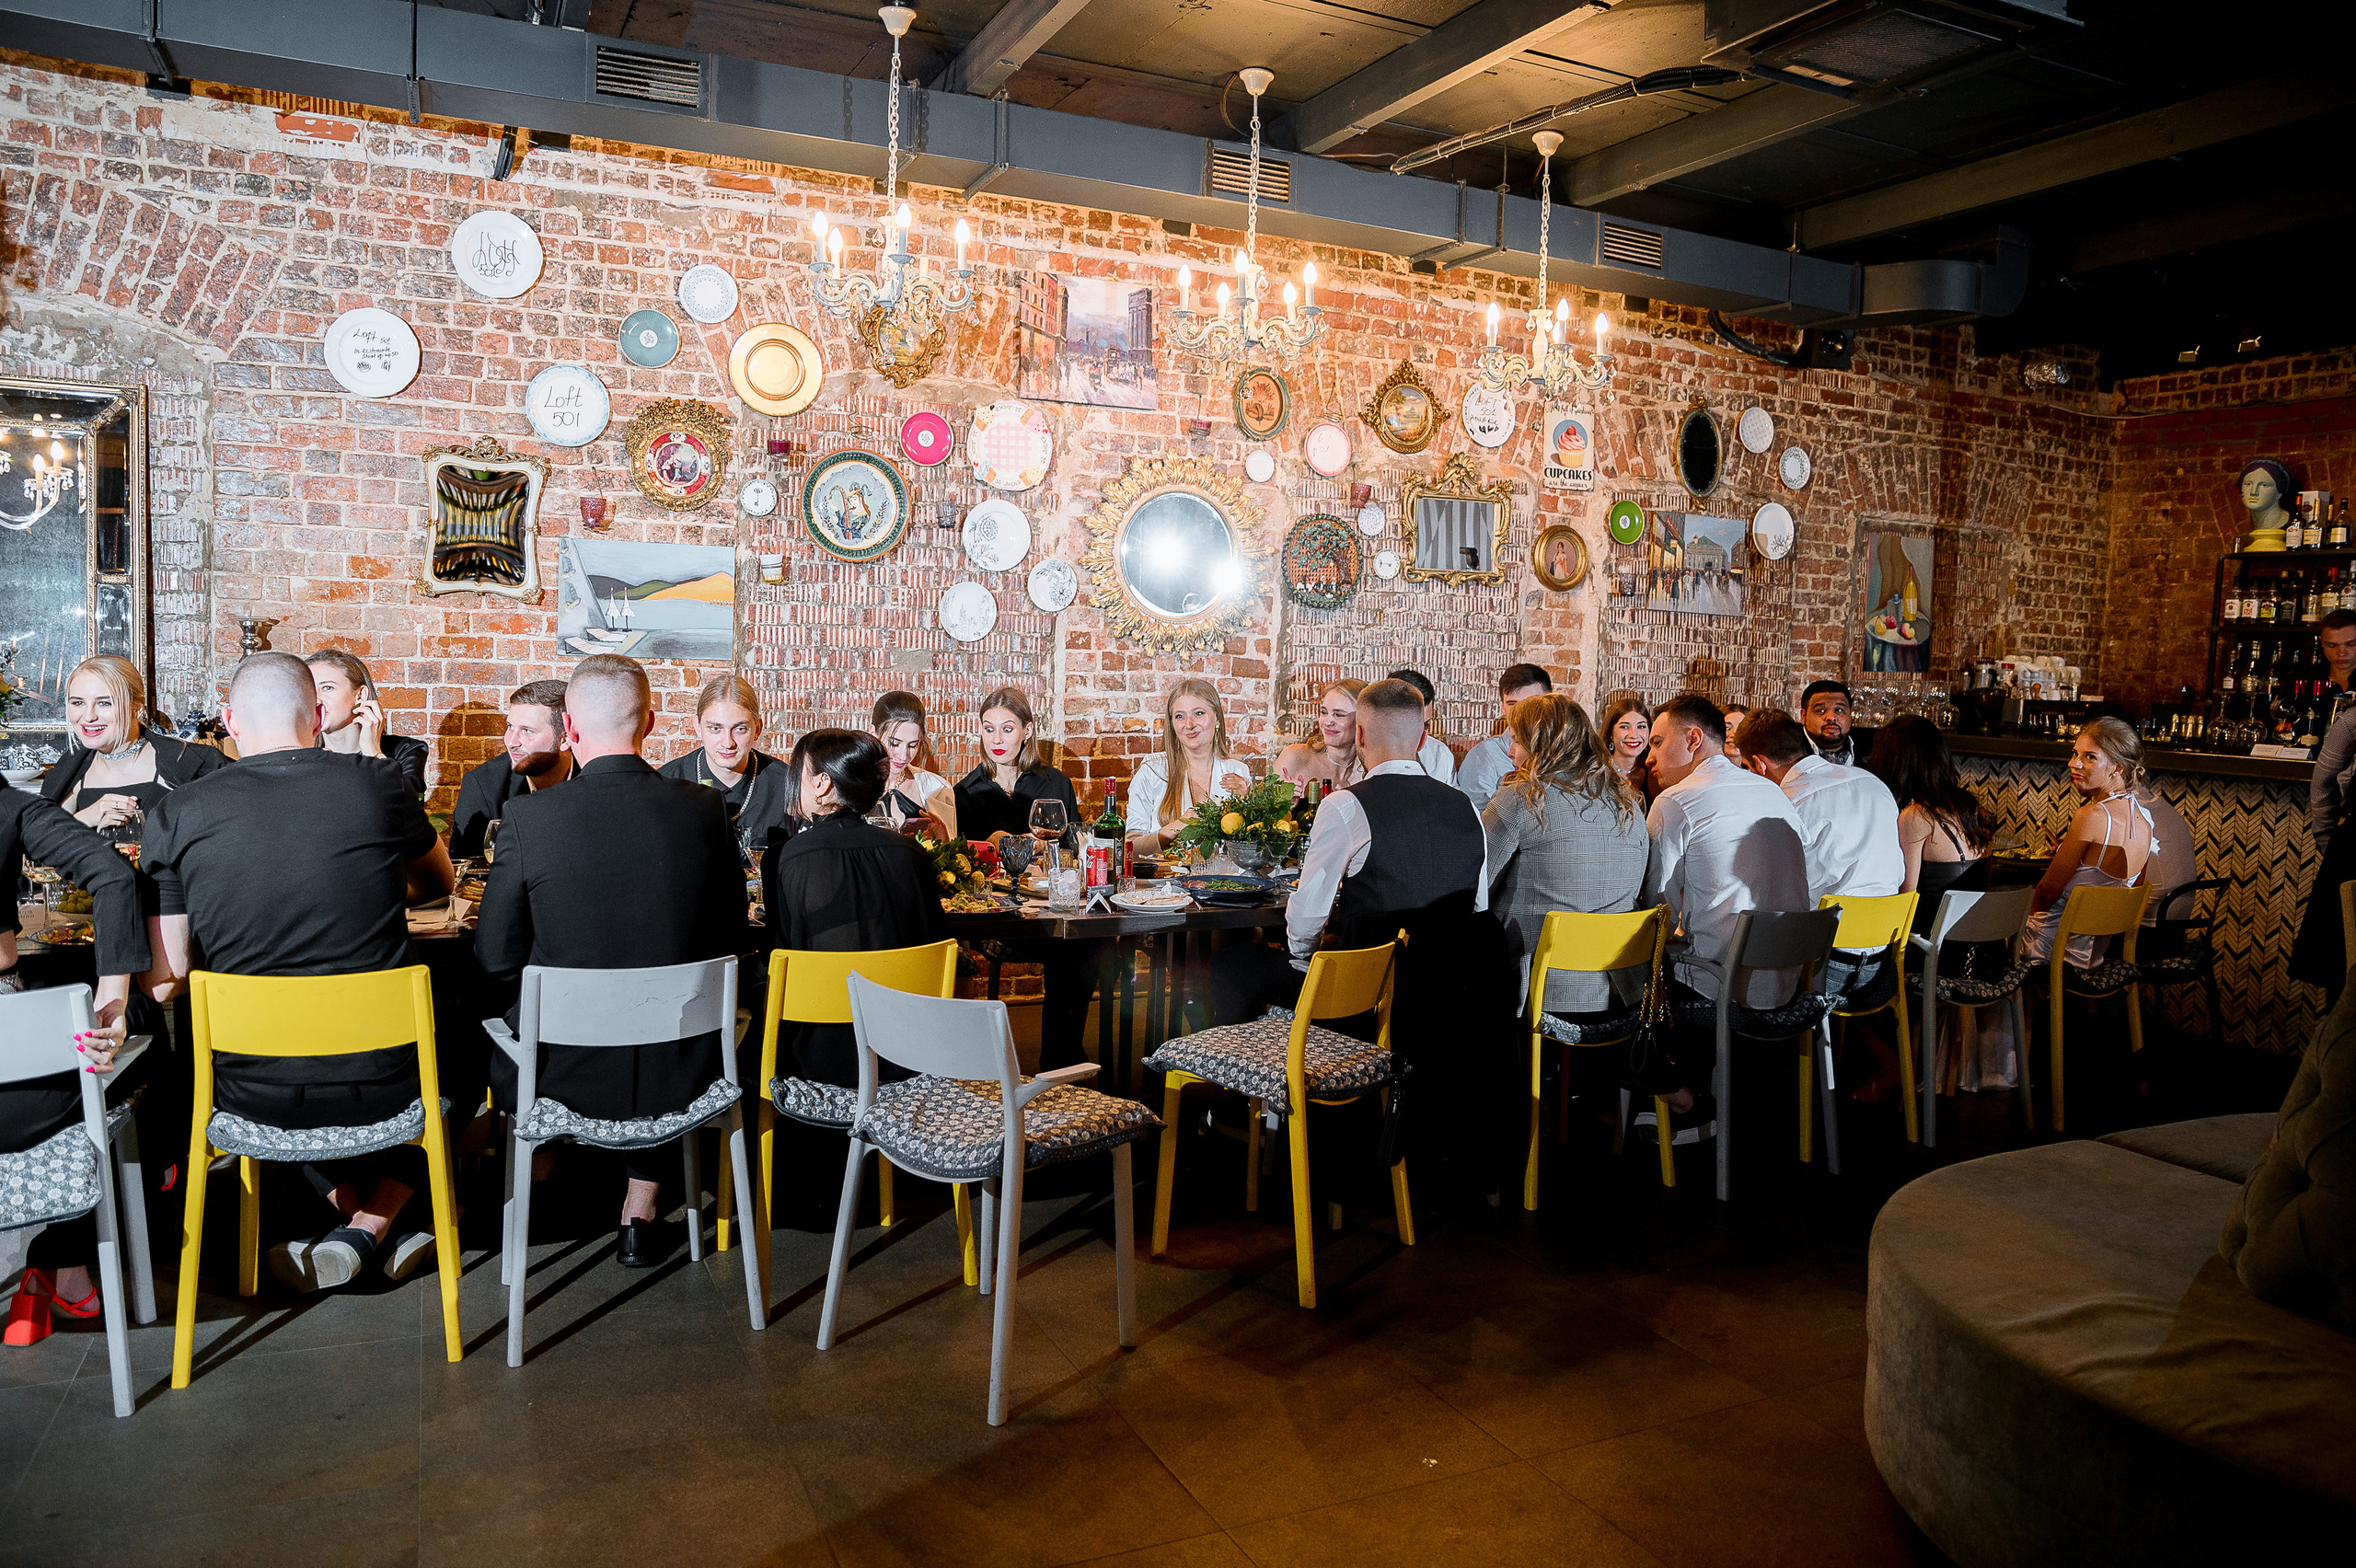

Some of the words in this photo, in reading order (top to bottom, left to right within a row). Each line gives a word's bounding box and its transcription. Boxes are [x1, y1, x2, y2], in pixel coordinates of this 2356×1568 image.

[544, 386, 583, 408] Loft
[552, 411, 580, 427] 501
[1481, 407, 1496, 416] 501
[1544, 467, 1592, 481] CUPCAKES
